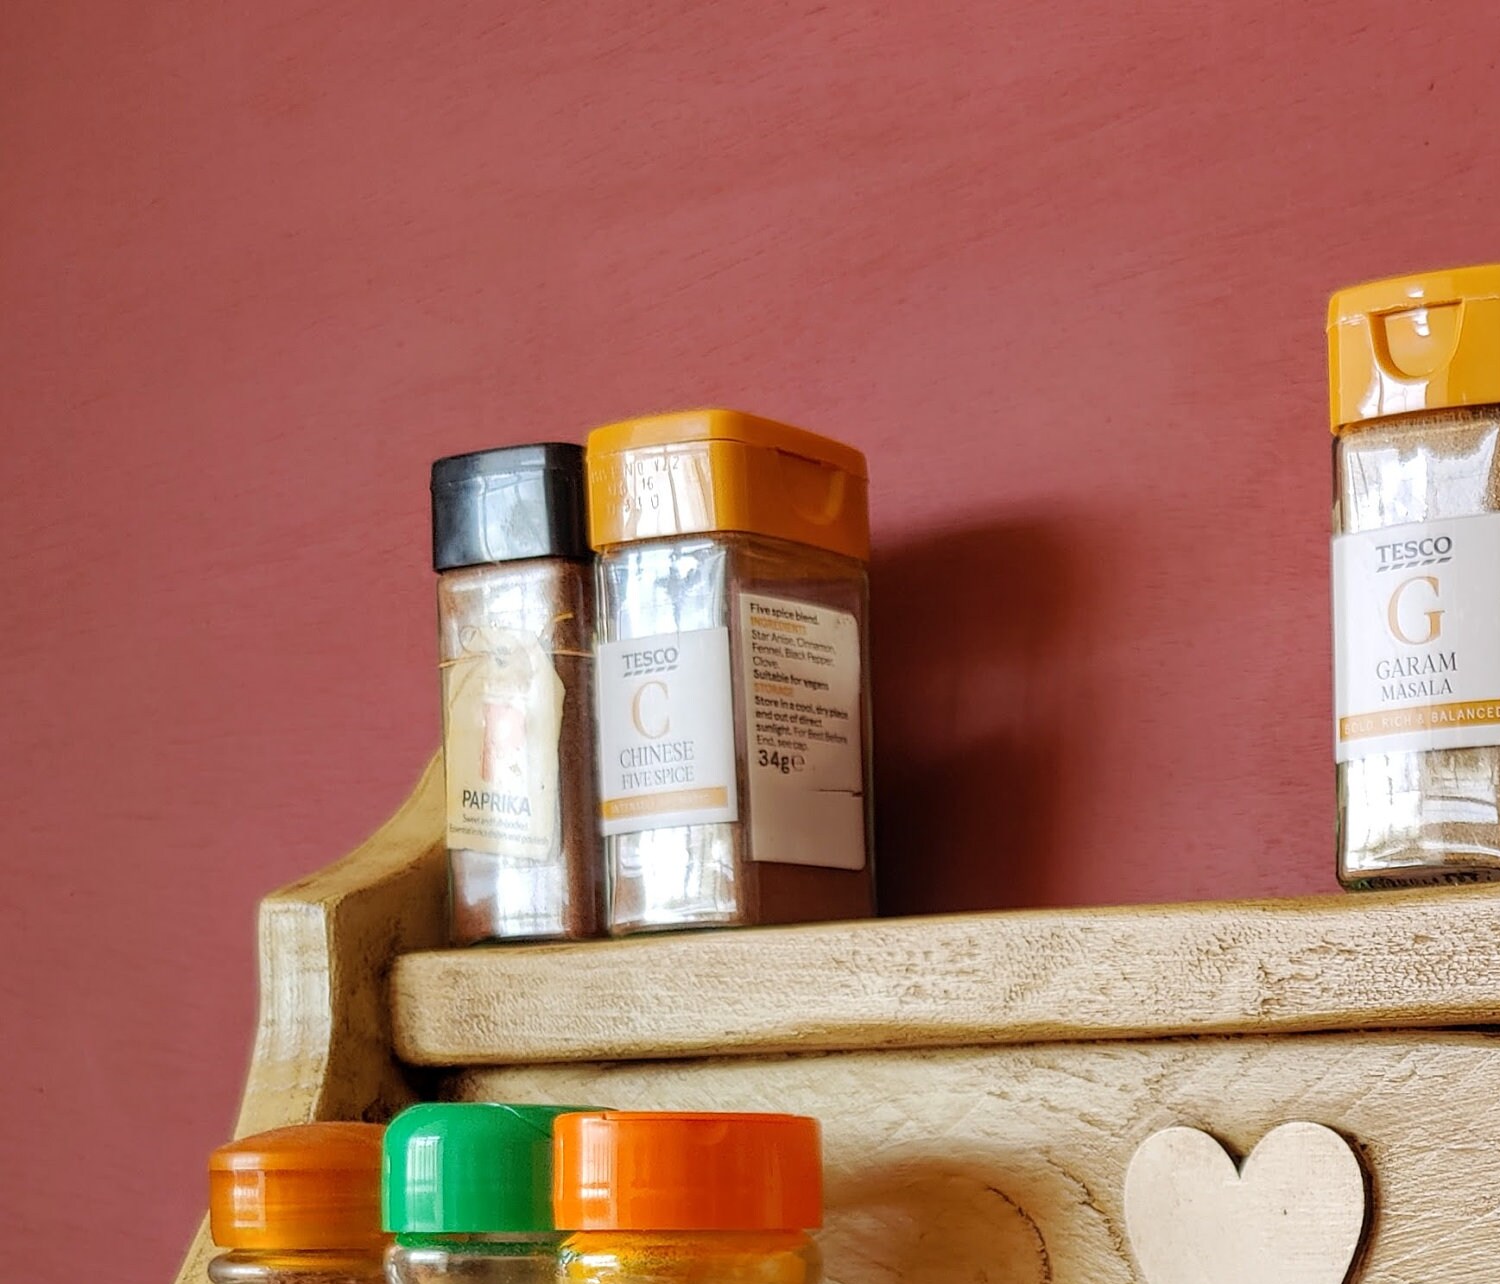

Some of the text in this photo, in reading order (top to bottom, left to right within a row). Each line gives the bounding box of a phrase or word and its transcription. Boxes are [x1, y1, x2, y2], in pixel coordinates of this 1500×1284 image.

[1376, 536, 1453, 563] TESCO
[750, 602, 771, 616] Five
[772, 607, 794, 620] spice
[1387, 576, 1445, 645] G
[751, 629, 769, 641] Star
[622, 647, 679, 670] TESCO
[1376, 652, 1458, 681] GARAM
[753, 668, 790, 681] Suitable
[755, 695, 779, 707] Store
[1382, 678, 1453, 702] MASALA
[631, 680, 670, 740] C
[1382, 716, 1412, 728] RICH
[620, 741, 694, 769] CHINESE
[622, 766, 694, 790] FIVE SPICE
[462, 789, 531, 817] PAPRIKA
